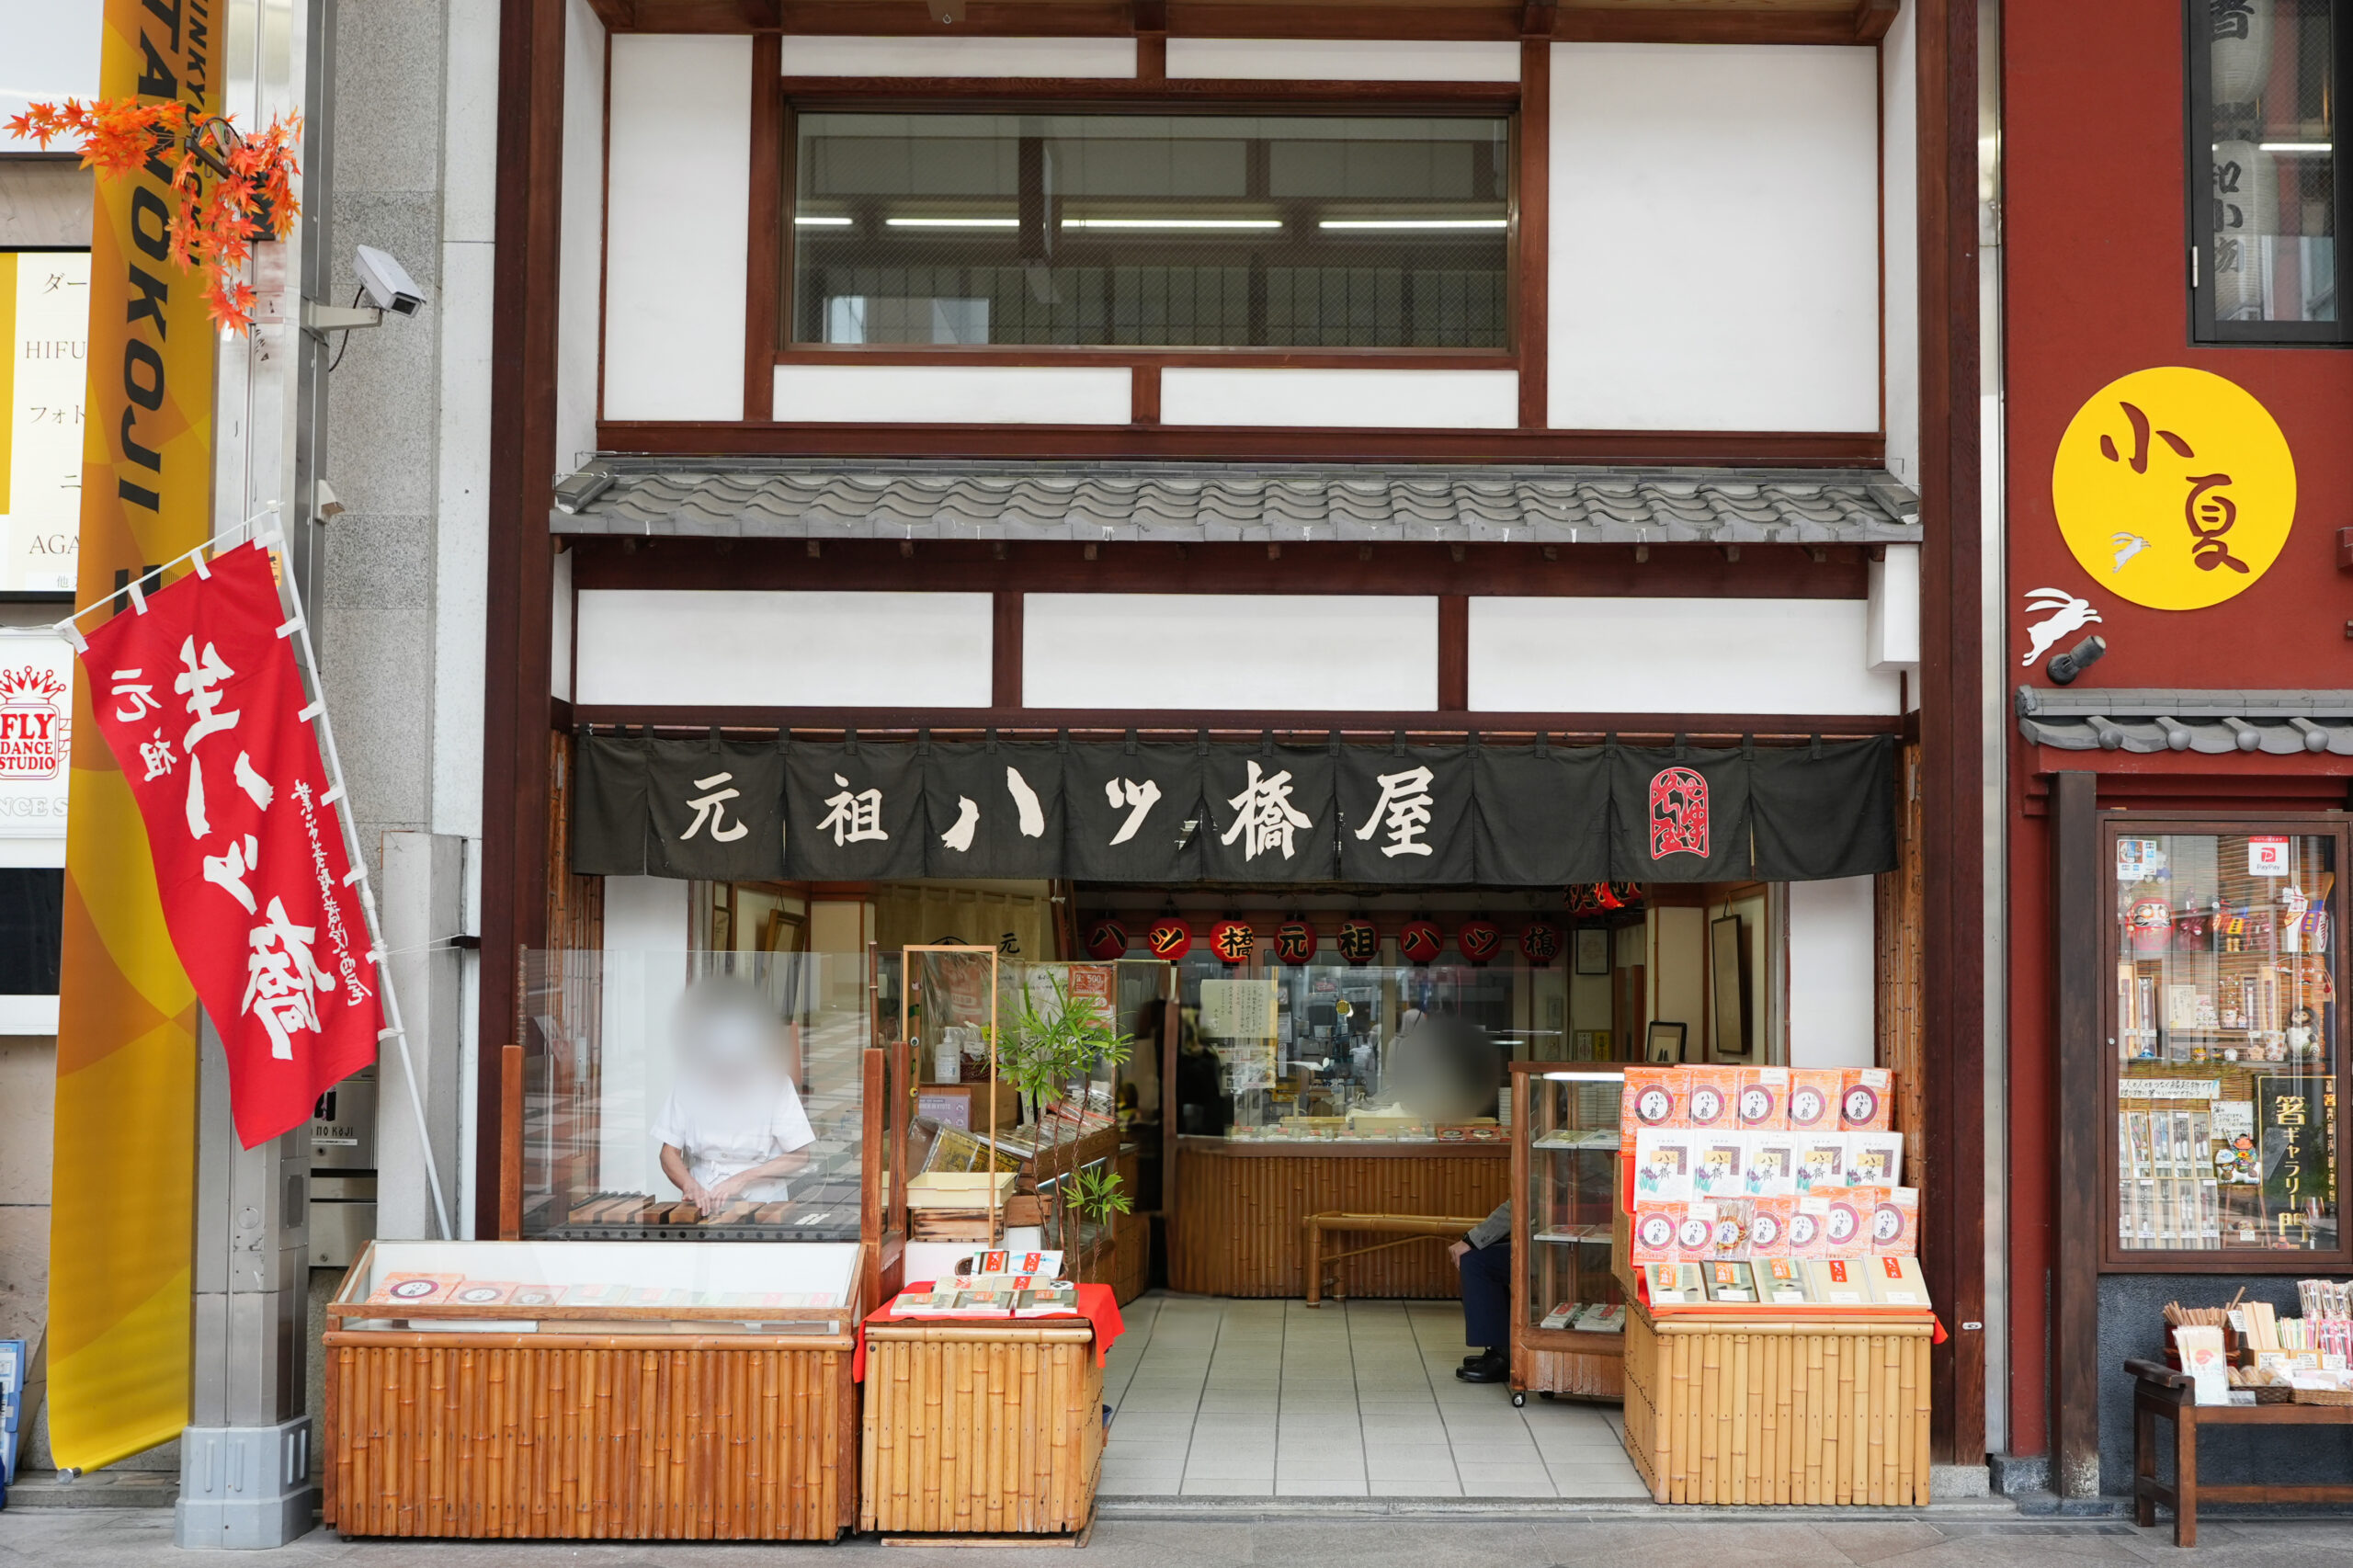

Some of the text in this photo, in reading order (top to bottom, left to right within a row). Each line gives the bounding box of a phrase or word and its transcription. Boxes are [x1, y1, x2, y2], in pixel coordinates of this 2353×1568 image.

[1, 713, 56, 740] FLY
[0, 741, 53, 755] DANCE
[0, 756, 55, 770] STUDIO
